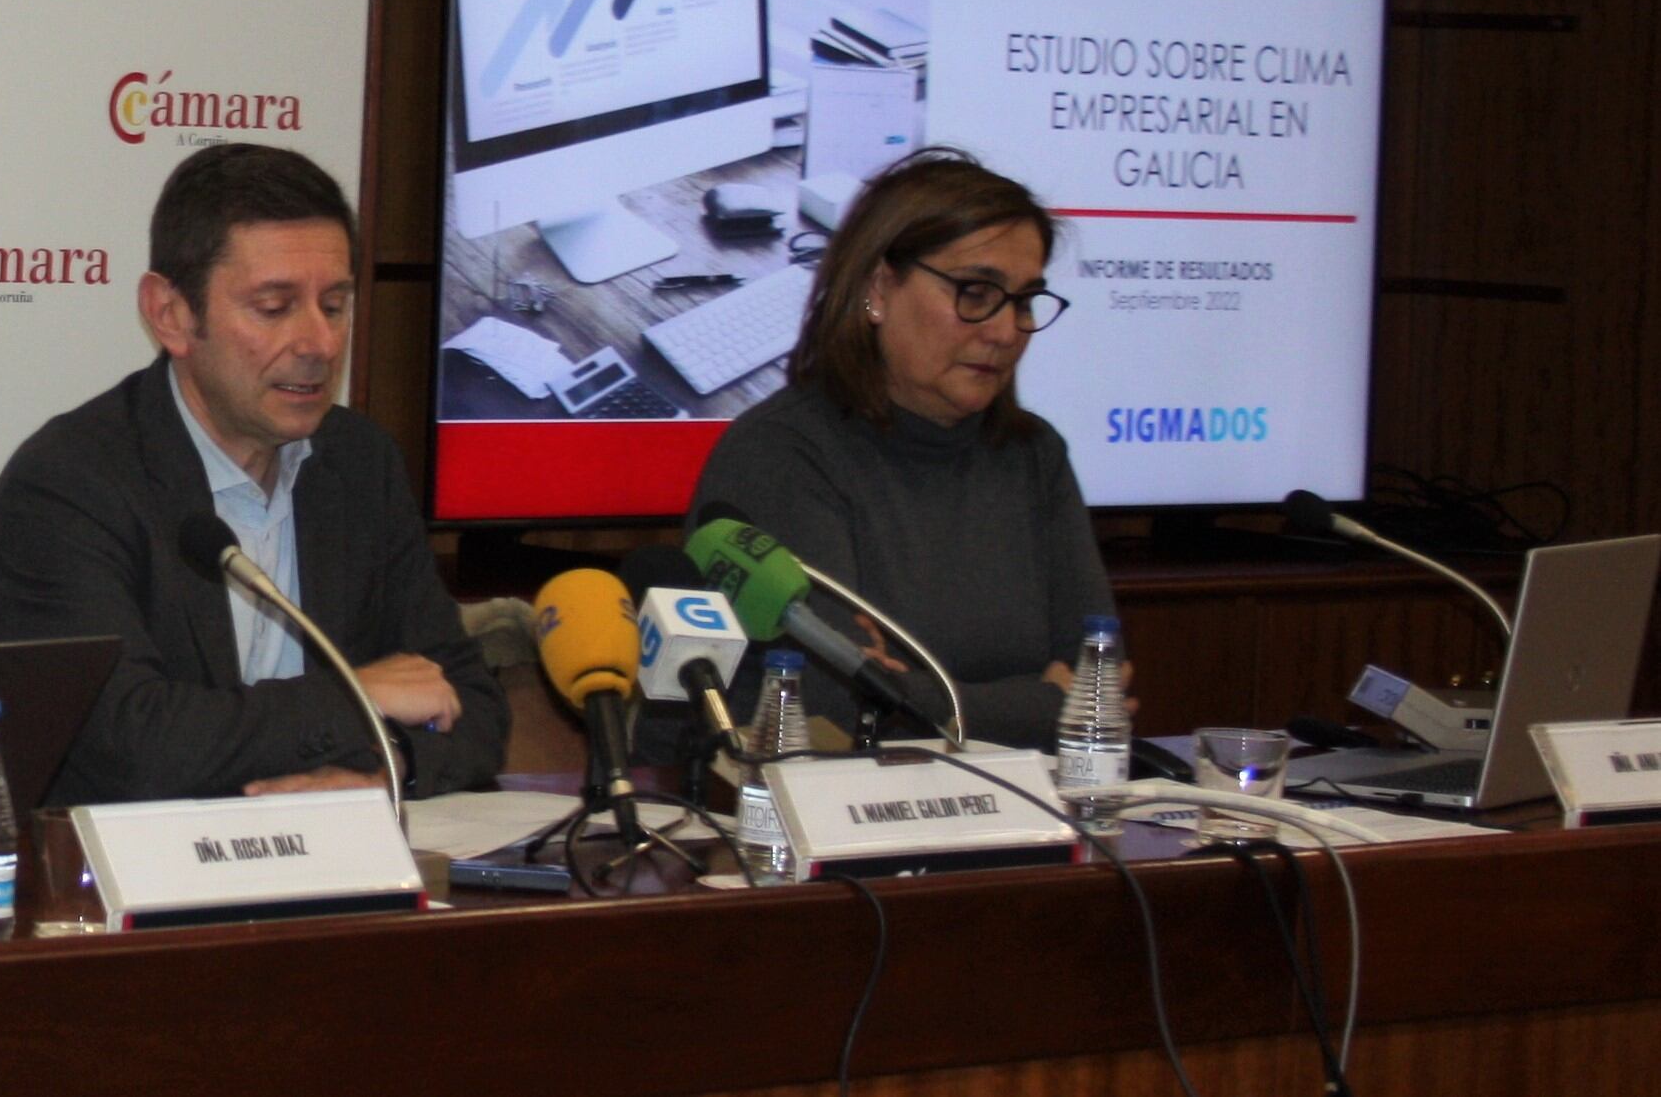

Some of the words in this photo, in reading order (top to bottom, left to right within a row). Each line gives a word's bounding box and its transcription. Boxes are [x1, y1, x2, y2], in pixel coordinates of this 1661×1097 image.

[1006, 33, 1136, 77] ESTUDIO
[1147, 40, 1245, 82] SOBRE
[1255, 46, 1353, 86] CLIMA
[1052, 92, 1260, 136] EMPRESARIAL
[1270, 100, 1309, 137] EN
[1114, 149, 1244, 189] GALICIA
[1078, 260, 1150, 279] INFORME
[1155, 260, 1174, 279] DE
[1179, 261, 1273, 281] RESULTADOS
[1109, 290, 1200, 311] Septiembre
[1106, 407, 1267, 443] SIGMADOS
[862, 800, 918, 823] MANUEL
[231, 837, 273, 860] ROSA
